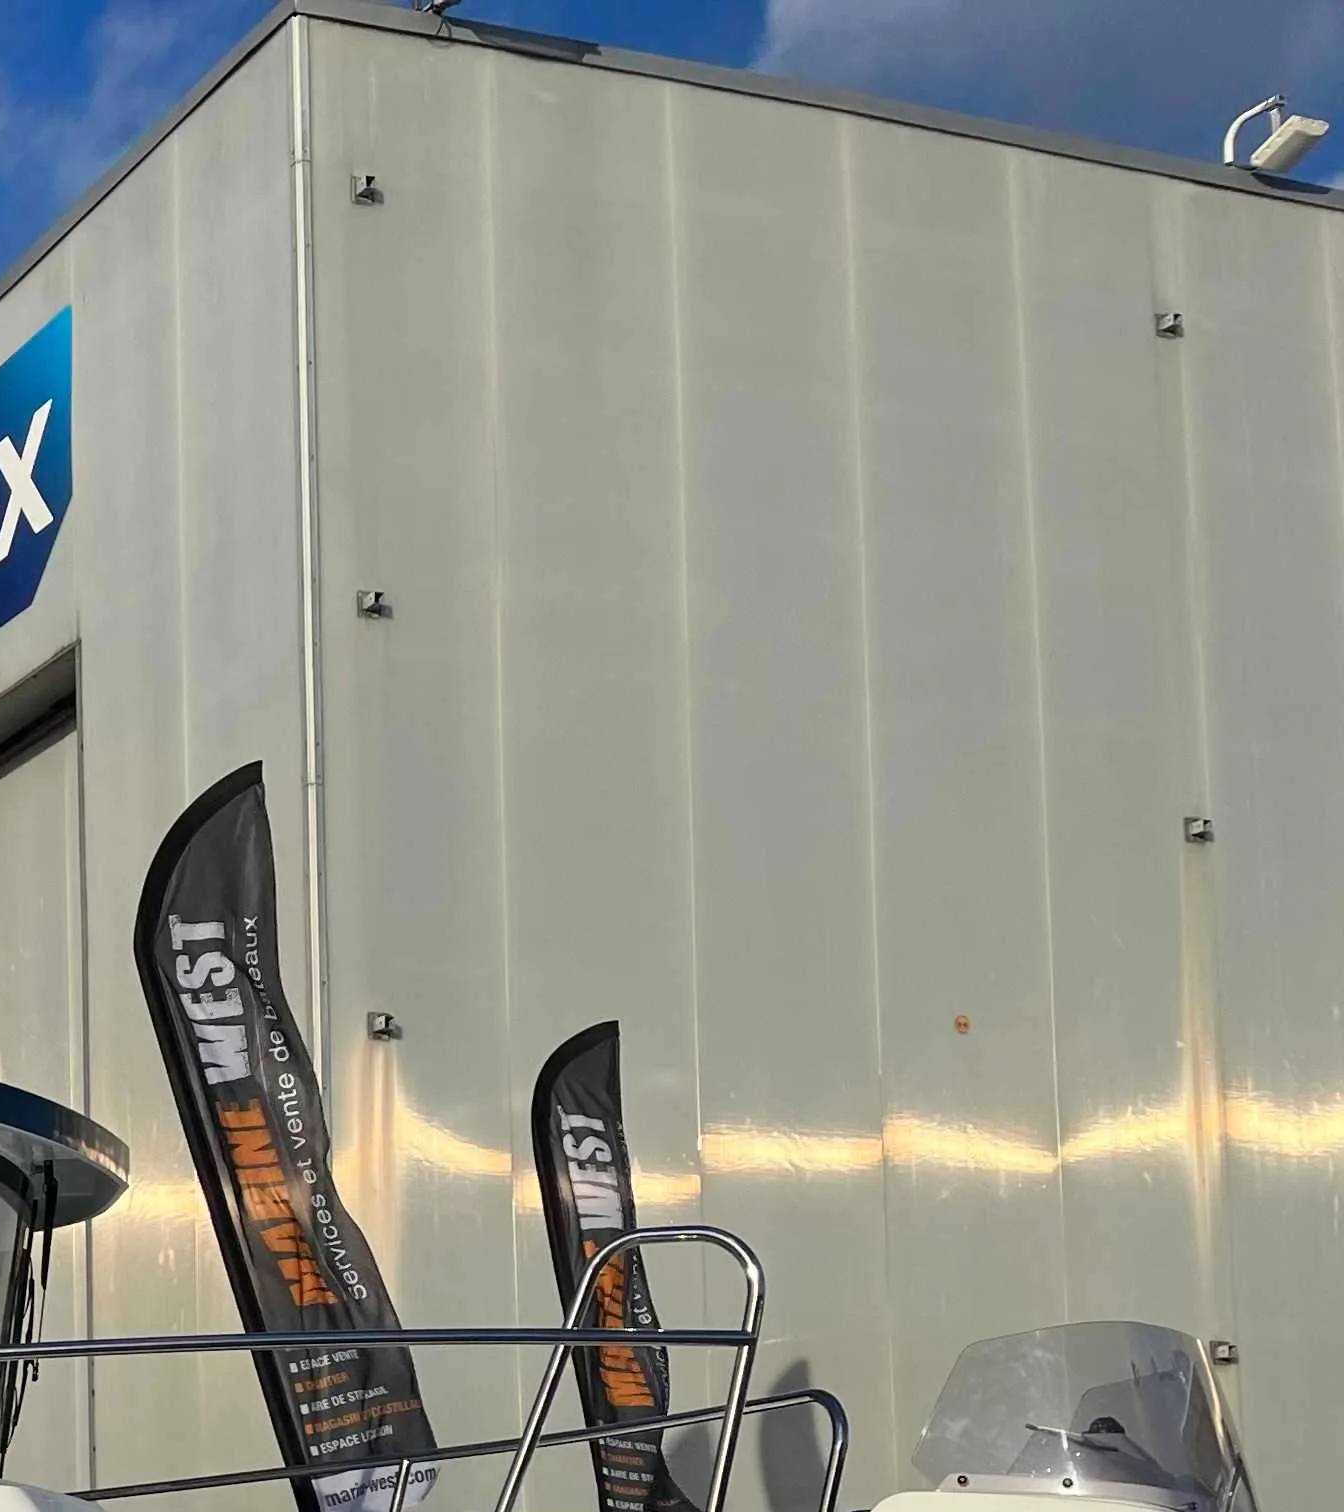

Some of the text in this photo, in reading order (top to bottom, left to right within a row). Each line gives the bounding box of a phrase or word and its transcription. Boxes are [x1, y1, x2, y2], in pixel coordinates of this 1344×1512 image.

[168, 914, 339, 1307] MARINE WEST
[243, 915, 368, 1302] Services et vente de beaux
[557, 1105, 625, 1231] WEST
[319, 1433, 361, 1454] ESPACE
[330, 1393, 345, 1407] DE
